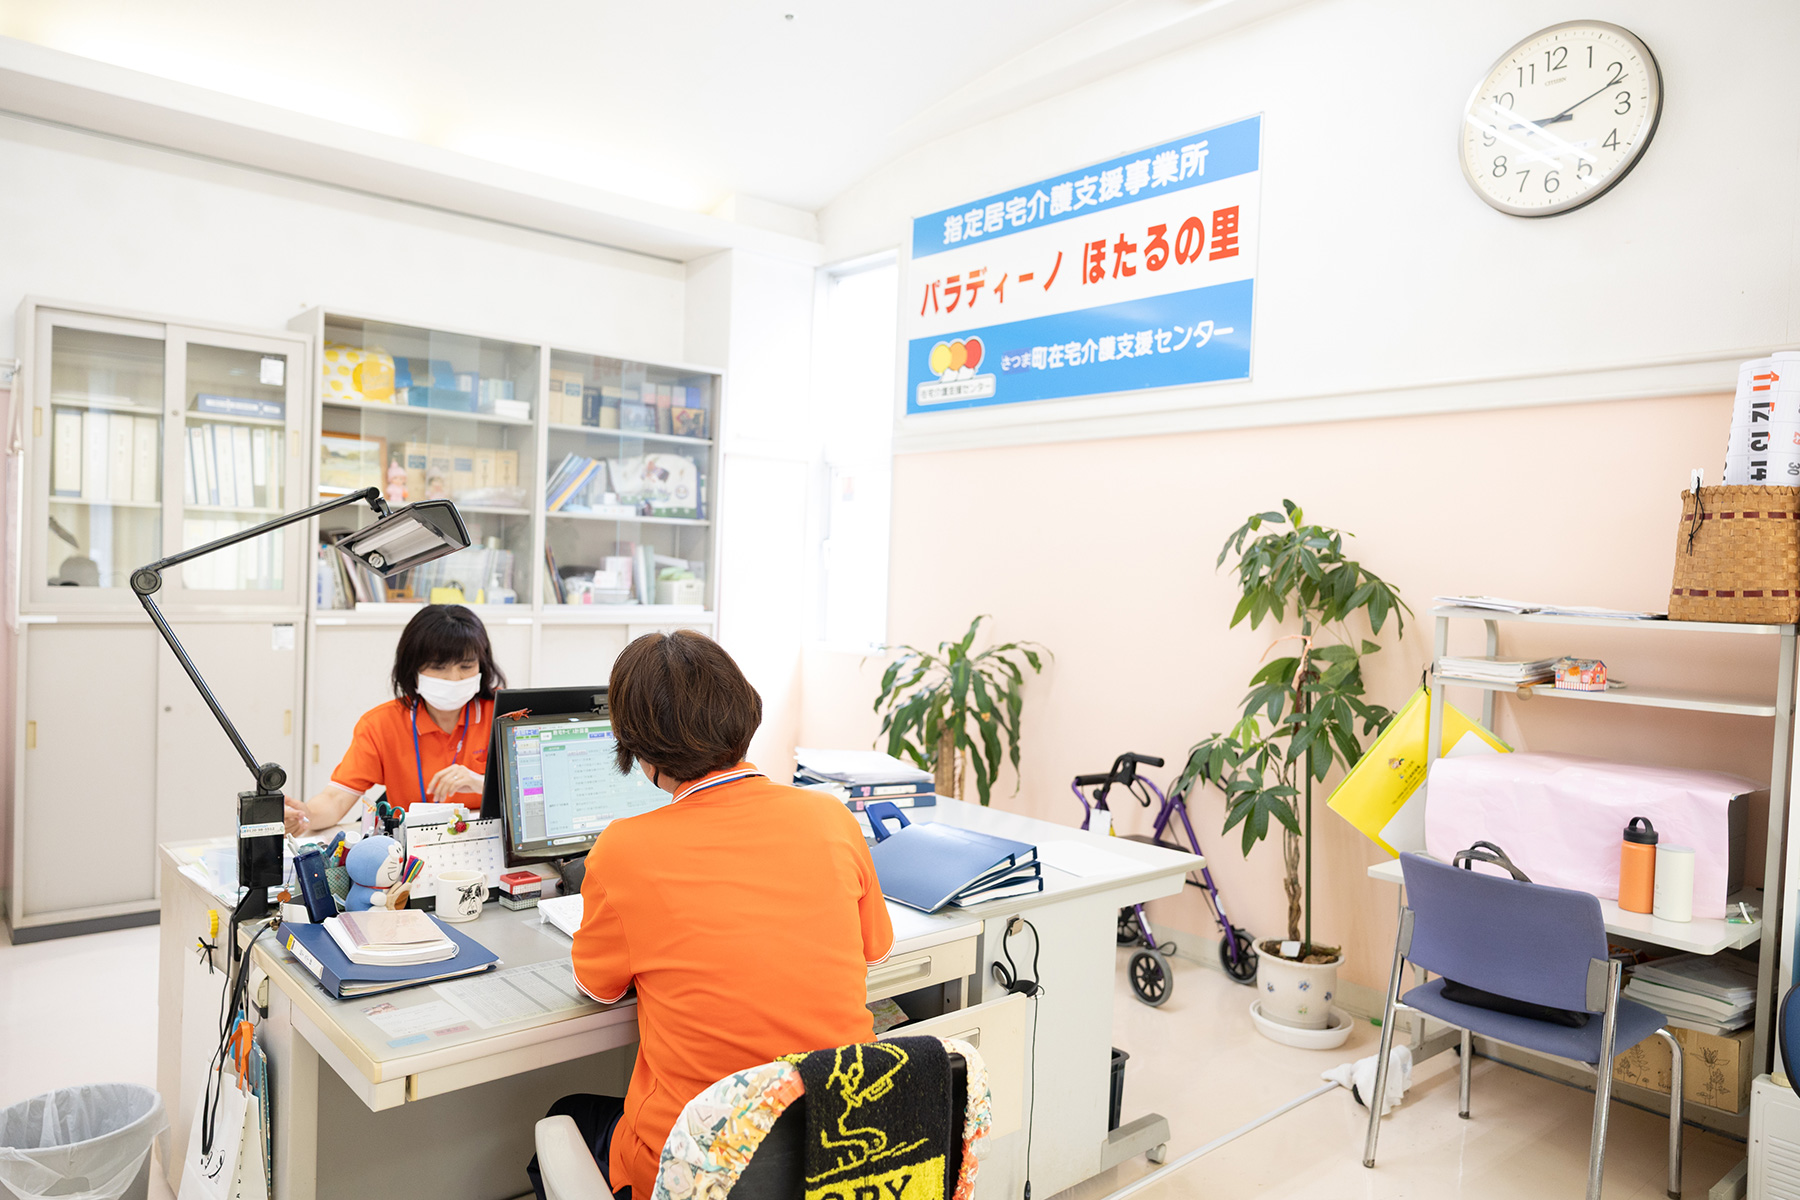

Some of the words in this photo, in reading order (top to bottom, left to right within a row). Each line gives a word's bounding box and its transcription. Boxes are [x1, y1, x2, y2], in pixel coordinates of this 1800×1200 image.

[1545, 46, 1568, 72] 12
[1586, 45, 1593, 69] 1
[1517, 63, 1535, 87] 11
[1606, 61, 1623, 87] 2
[1614, 90, 1631, 115] 3
[1601, 128, 1621, 151] 4
[1492, 155, 1507, 178] 8
[1576, 157, 1593, 180] 5
[943, 140, 1209, 245] 指定居宅介護支援事業所
[1515, 169, 1530, 193] 7
[1544, 170, 1560, 193] 6
[921, 250, 1063, 317] パラディーノ
[1082, 205, 1240, 285] ほたるの里
[1750, 460, 1767, 481] 14
[1787, 462, 1800, 476] 30
[437, 832, 443, 842] 7
